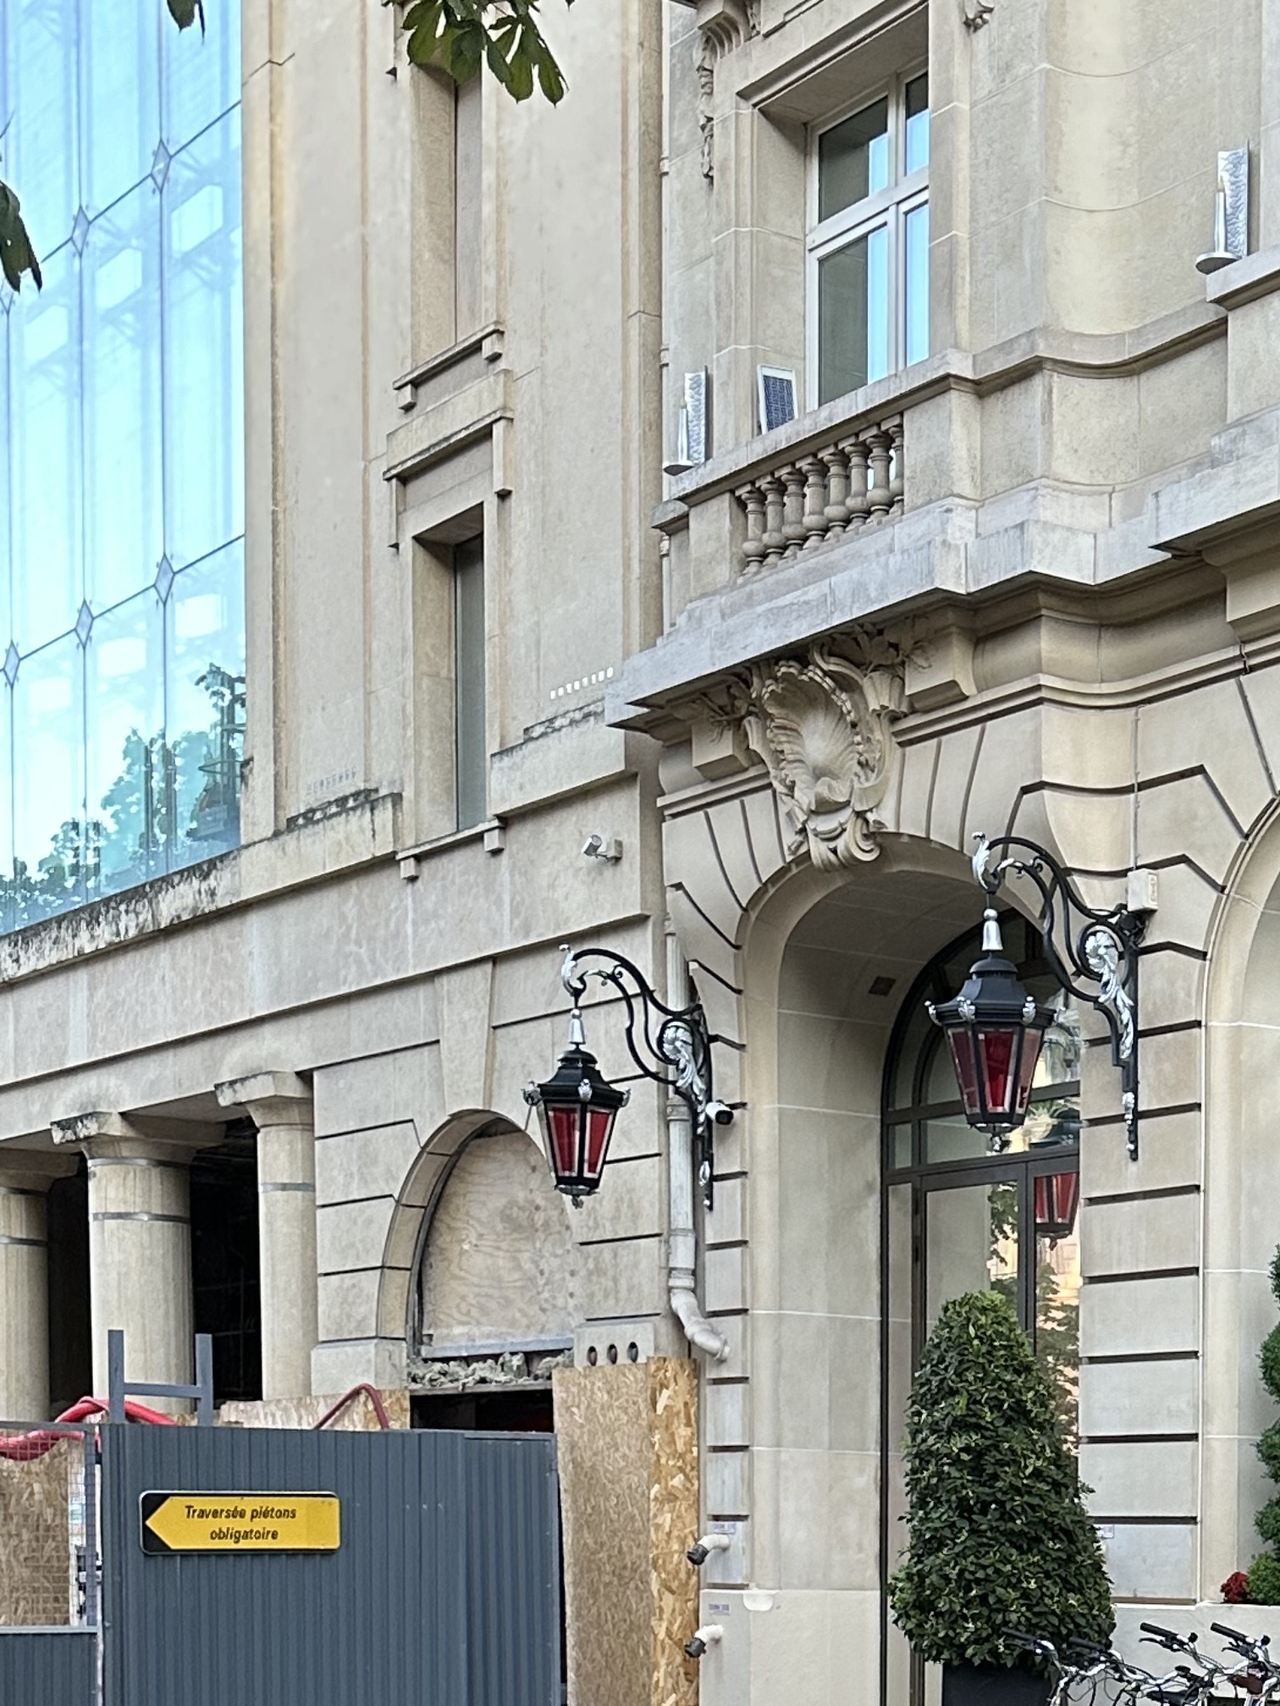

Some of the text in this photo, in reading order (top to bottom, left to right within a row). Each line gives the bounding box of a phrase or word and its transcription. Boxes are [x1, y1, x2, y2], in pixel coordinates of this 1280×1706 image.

[184, 1504, 297, 1523] Traversée piétons
[209, 1526, 279, 1545] obligatoire
